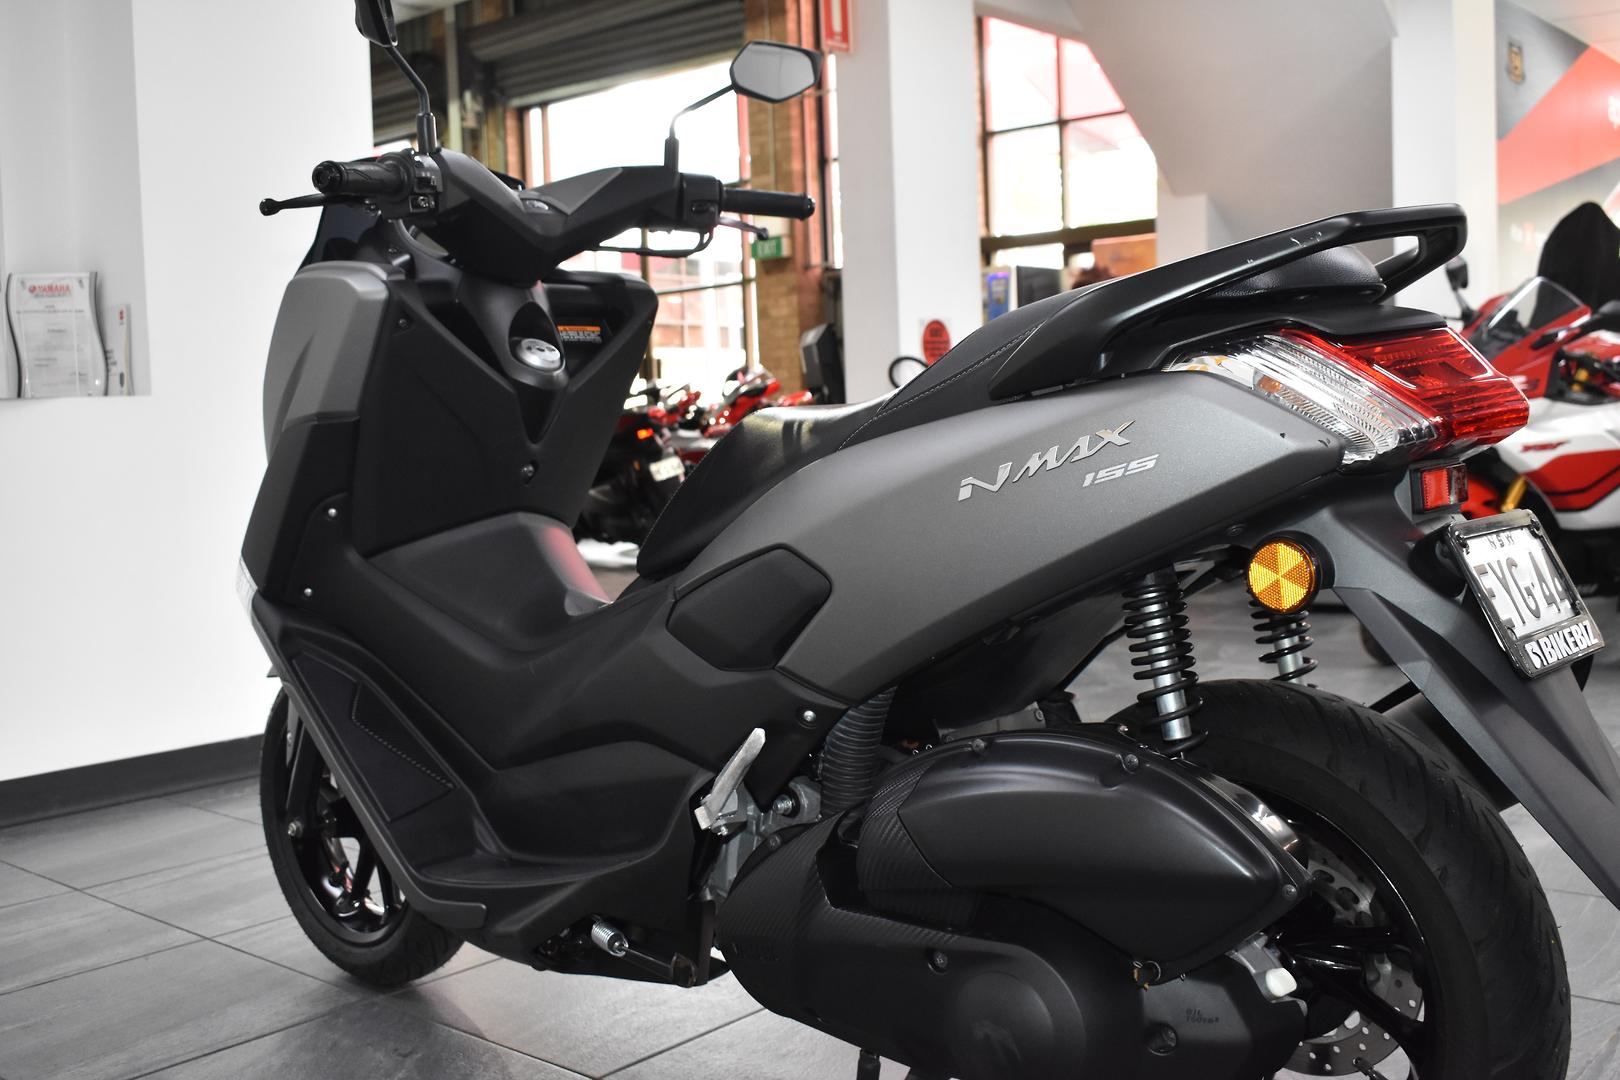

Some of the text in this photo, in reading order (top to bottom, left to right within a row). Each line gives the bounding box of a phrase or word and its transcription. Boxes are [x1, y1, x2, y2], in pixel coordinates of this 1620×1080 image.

[36, 284, 72, 294] YAMAHA
[957, 419, 1136, 502] NMAX
[1082, 453, 1160, 488] 155
